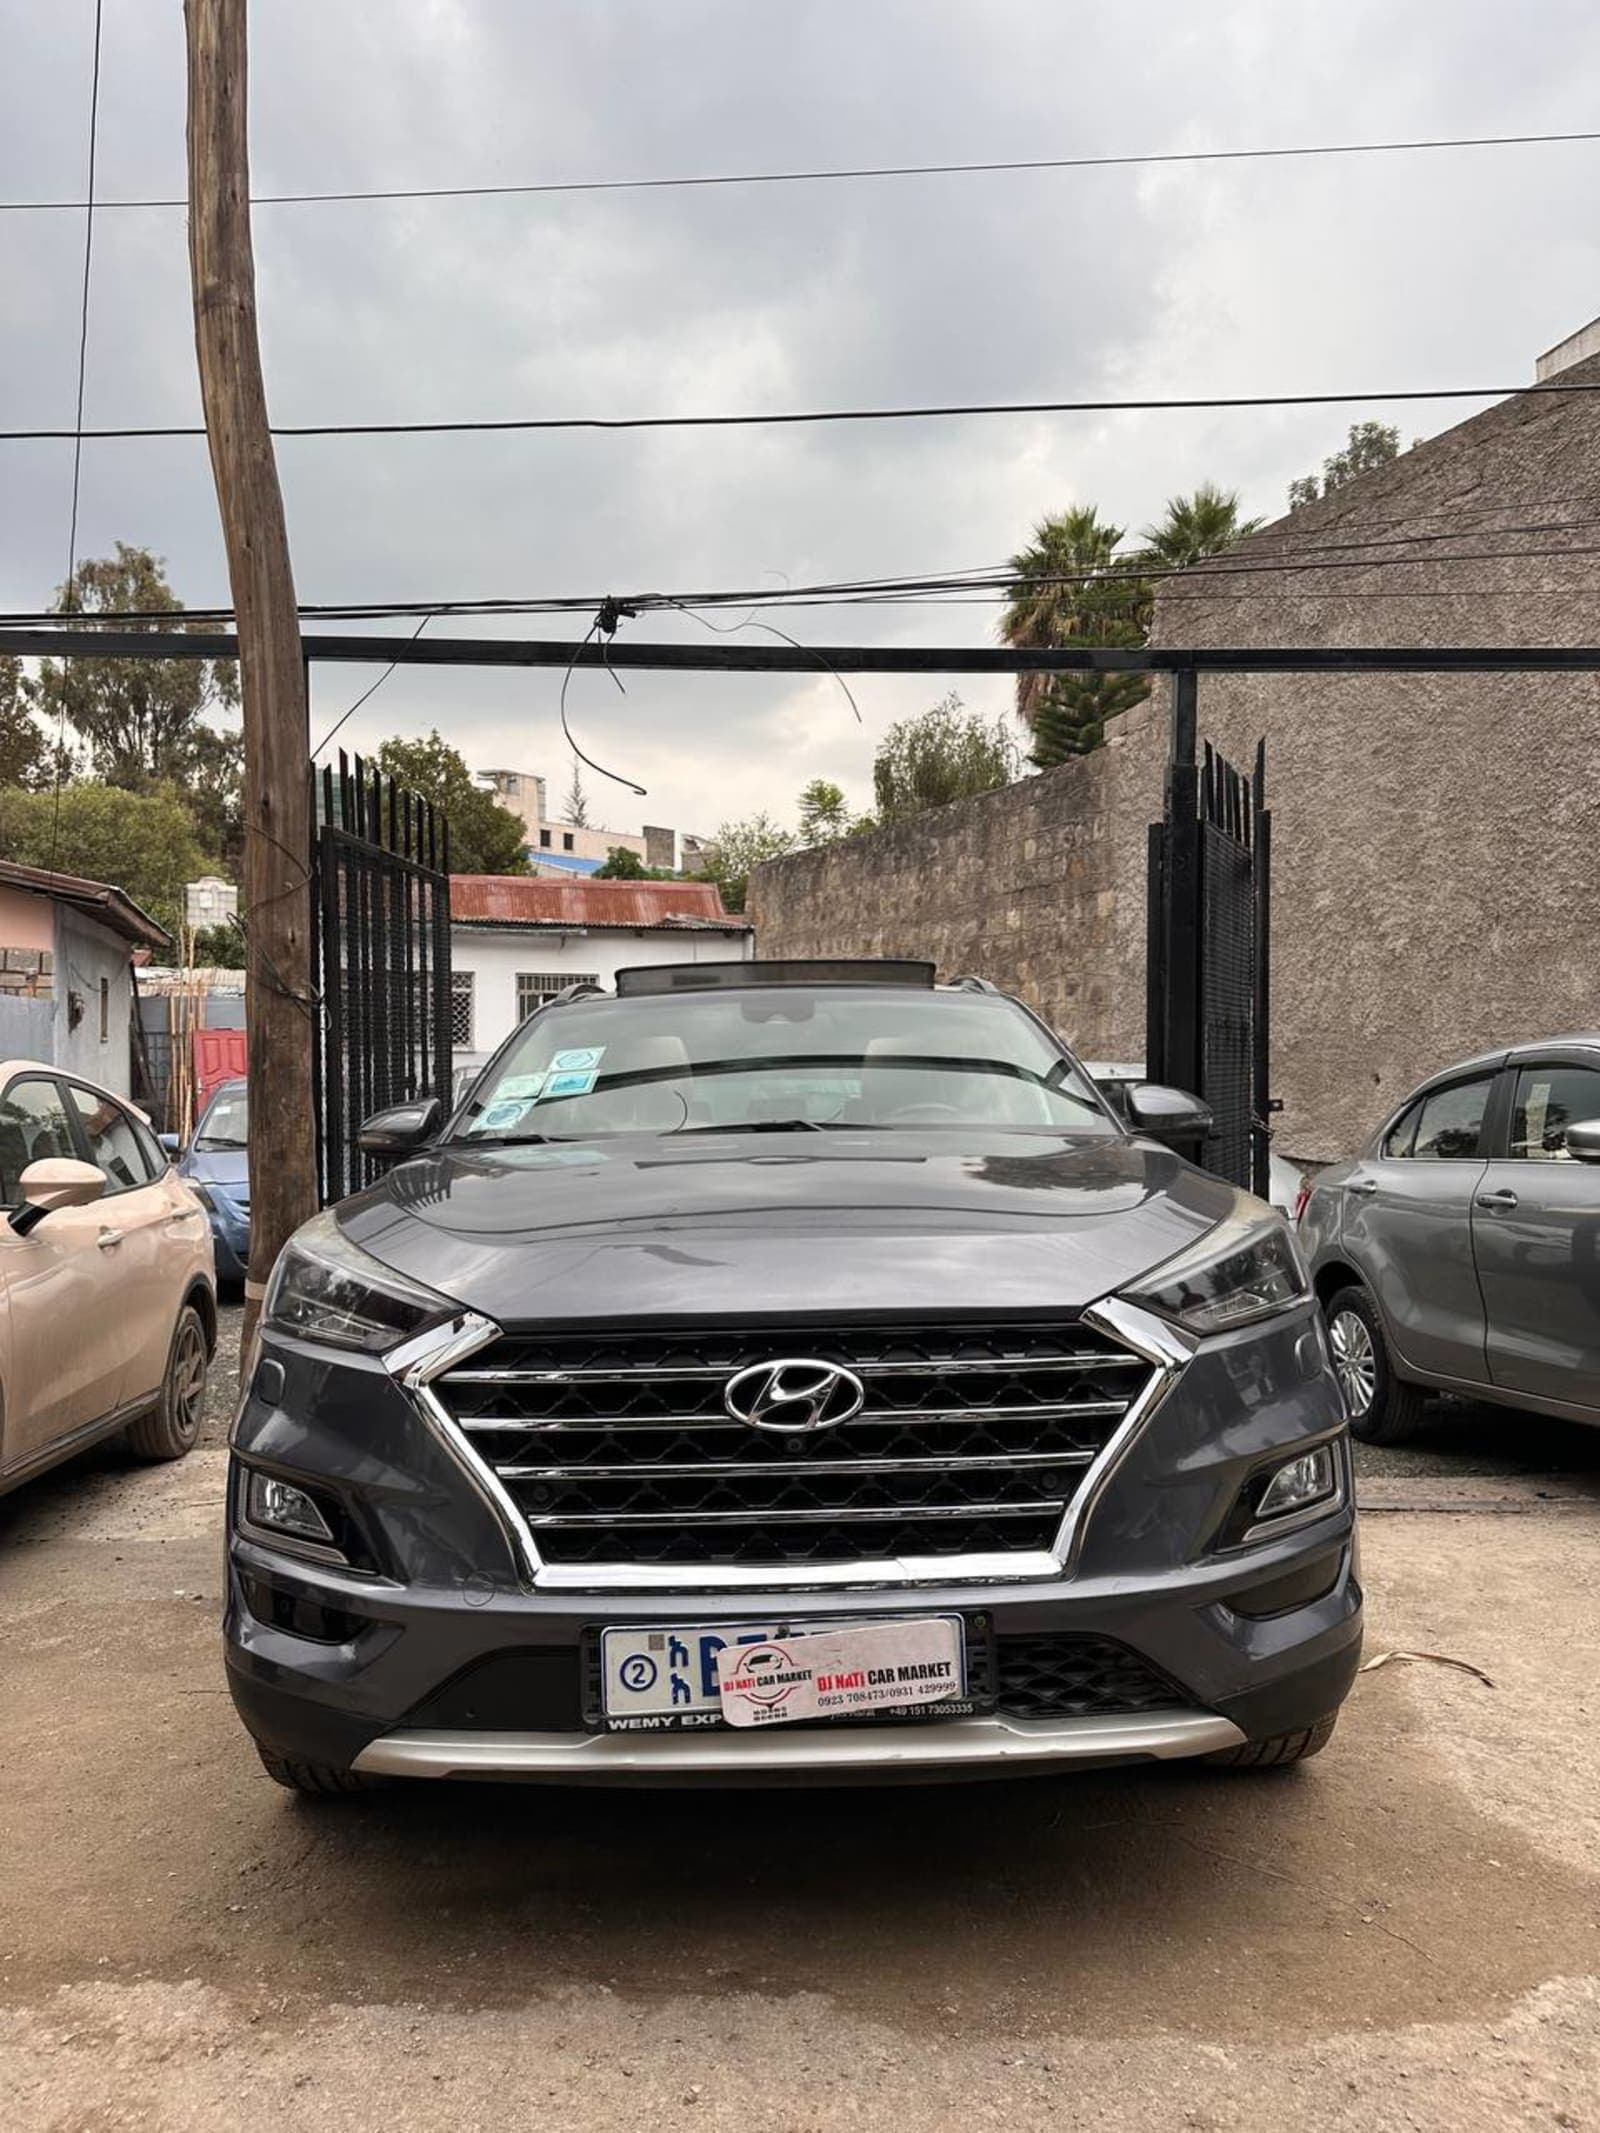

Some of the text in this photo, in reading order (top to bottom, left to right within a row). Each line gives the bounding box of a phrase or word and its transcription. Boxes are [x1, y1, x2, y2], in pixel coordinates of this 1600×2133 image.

[631, 1662, 646, 1685] 2
[757, 1674, 775, 1687] CAR
[776, 1669, 812, 1684] MARKET
[817, 1662, 951, 1692] DJ NATI CAR MARKET
[817, 1693, 844, 1707] 0923
[607, 1716, 676, 1730] WEMY
